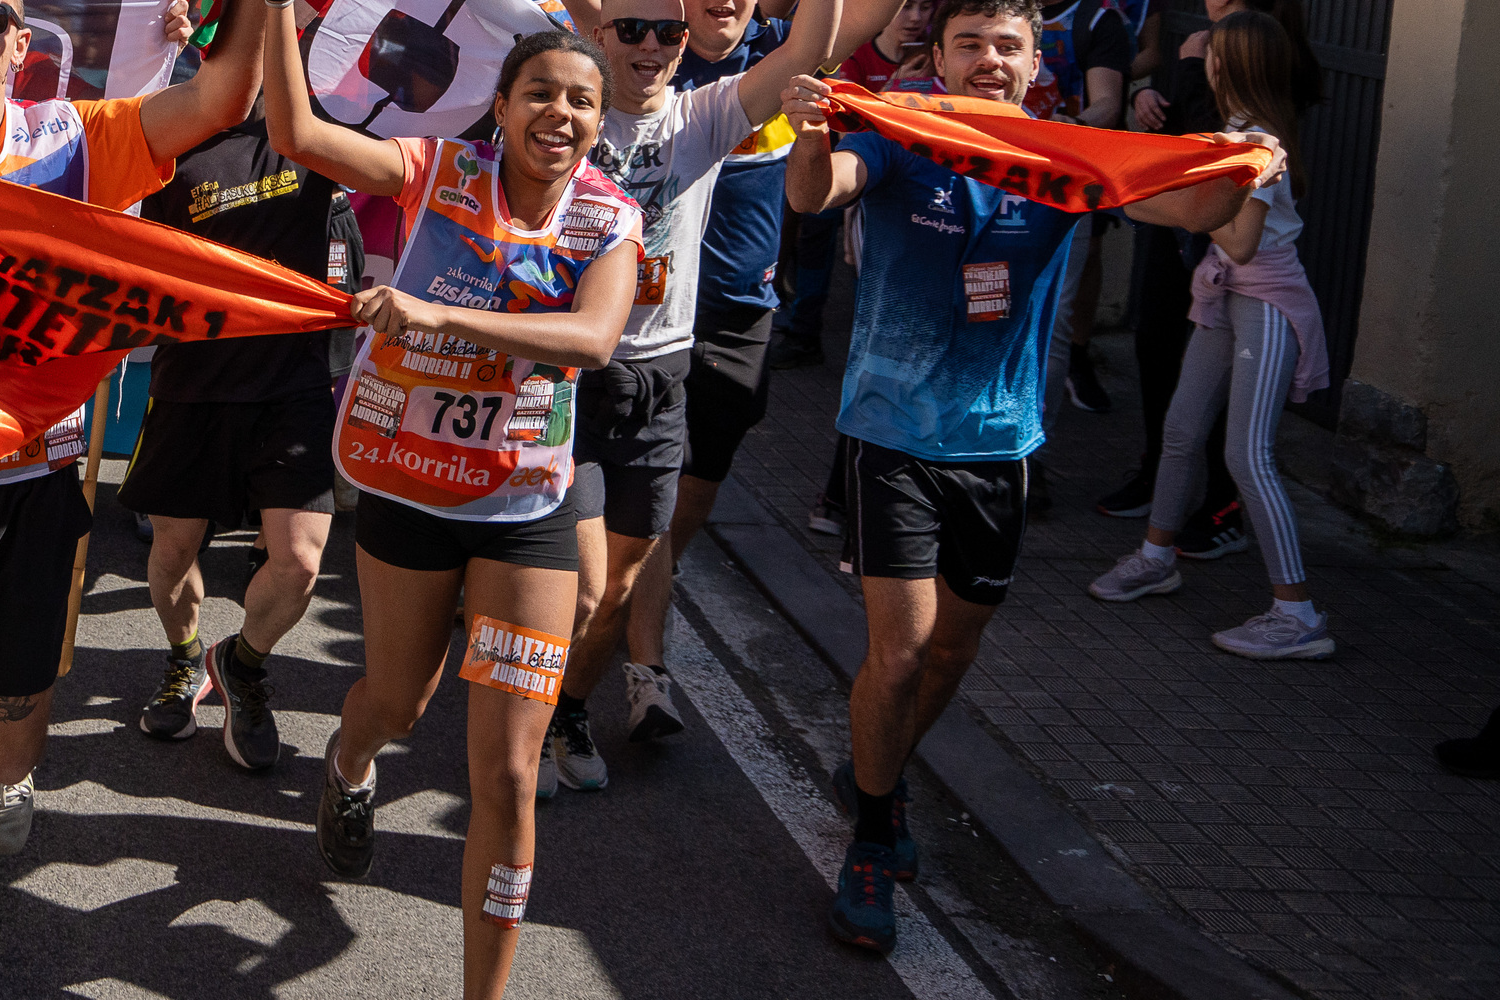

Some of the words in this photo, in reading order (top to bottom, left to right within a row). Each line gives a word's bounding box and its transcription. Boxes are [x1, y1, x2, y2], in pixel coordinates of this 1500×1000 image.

[32, 117, 69, 139] eitb
[205, 311, 227, 338] 1
[401, 351, 458, 377] AURRERA
[431, 391, 502, 441] 737
[348, 441, 491, 487] 24.korrika
[509, 455, 558, 487] aek
[490, 662, 546, 694] AURRERA
